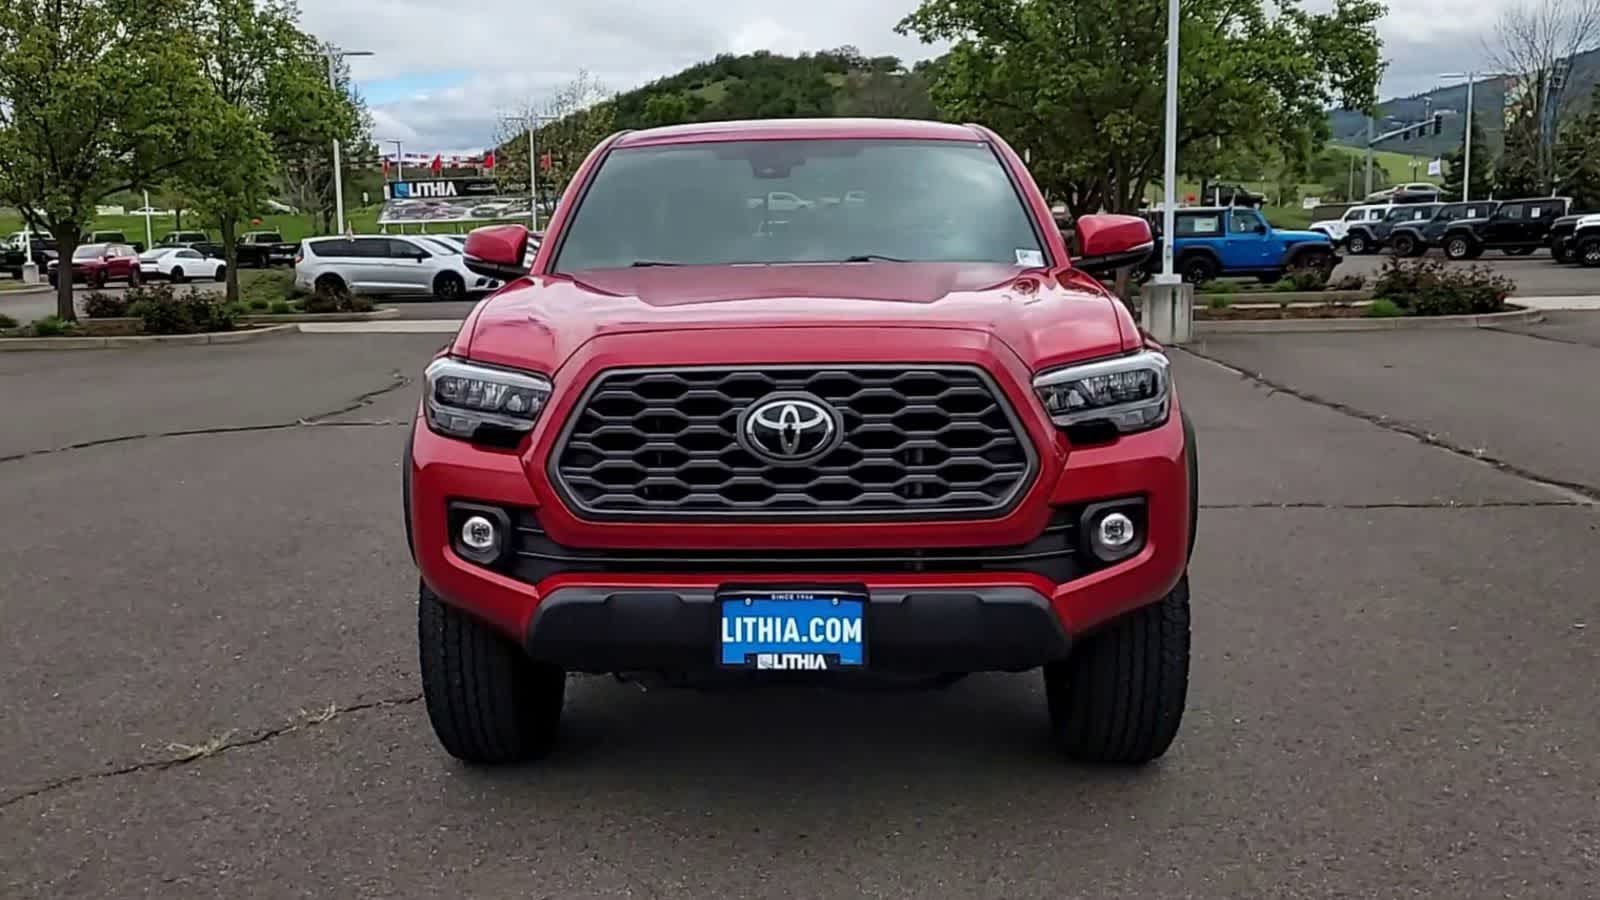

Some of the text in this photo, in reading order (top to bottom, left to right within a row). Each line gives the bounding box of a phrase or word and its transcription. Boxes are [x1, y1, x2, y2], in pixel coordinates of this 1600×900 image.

[409, 182, 457, 197] LITHIA
[722, 617, 862, 643] LITHIA.COM
[773, 654, 827, 670] LITHIA
